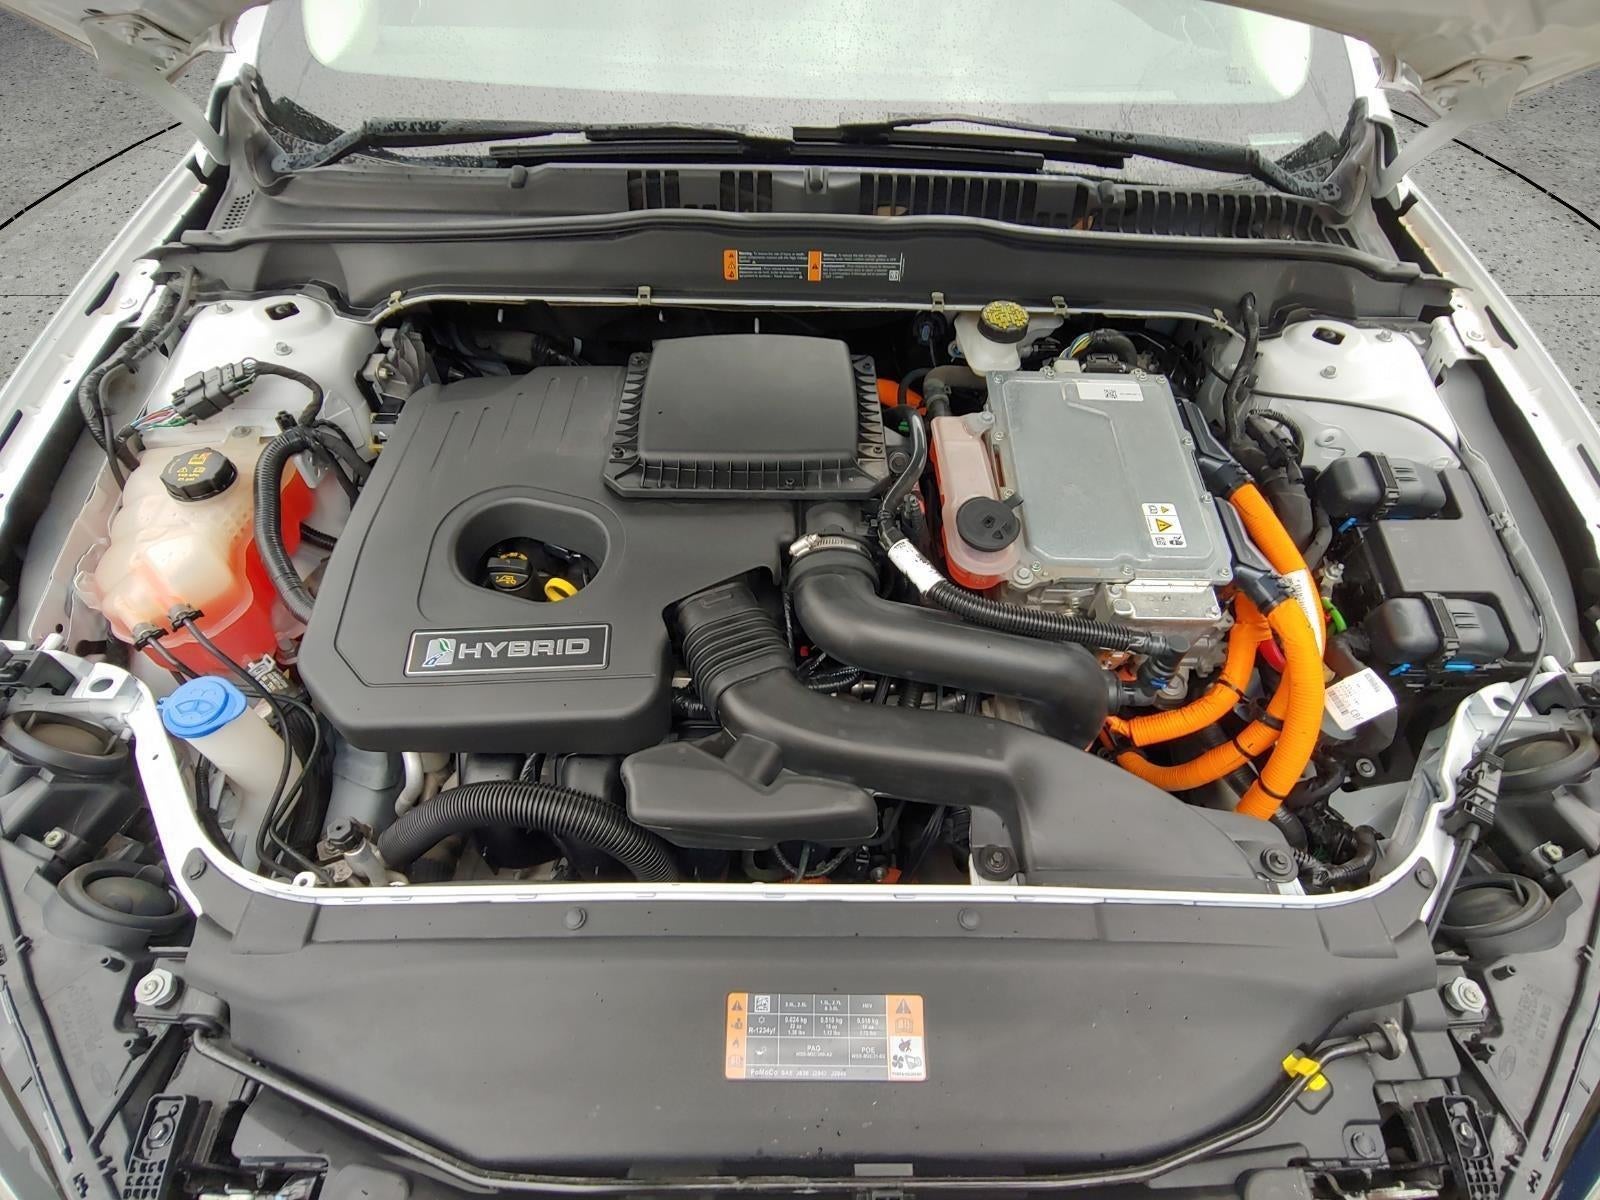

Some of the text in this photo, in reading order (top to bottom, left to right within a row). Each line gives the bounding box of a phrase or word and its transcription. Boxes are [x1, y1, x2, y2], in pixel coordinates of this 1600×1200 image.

[458, 638, 591, 659] HYBRID
[800, 1016, 808, 1024] kg
[835, 1016, 843, 1025] kg
[871, 1017, 879, 1025] kg
[748, 1026, 776, 1036] R-1234yf
[861, 1046, 876, 1054] POE
[750, 1068, 778, 1076] FoMoCo
